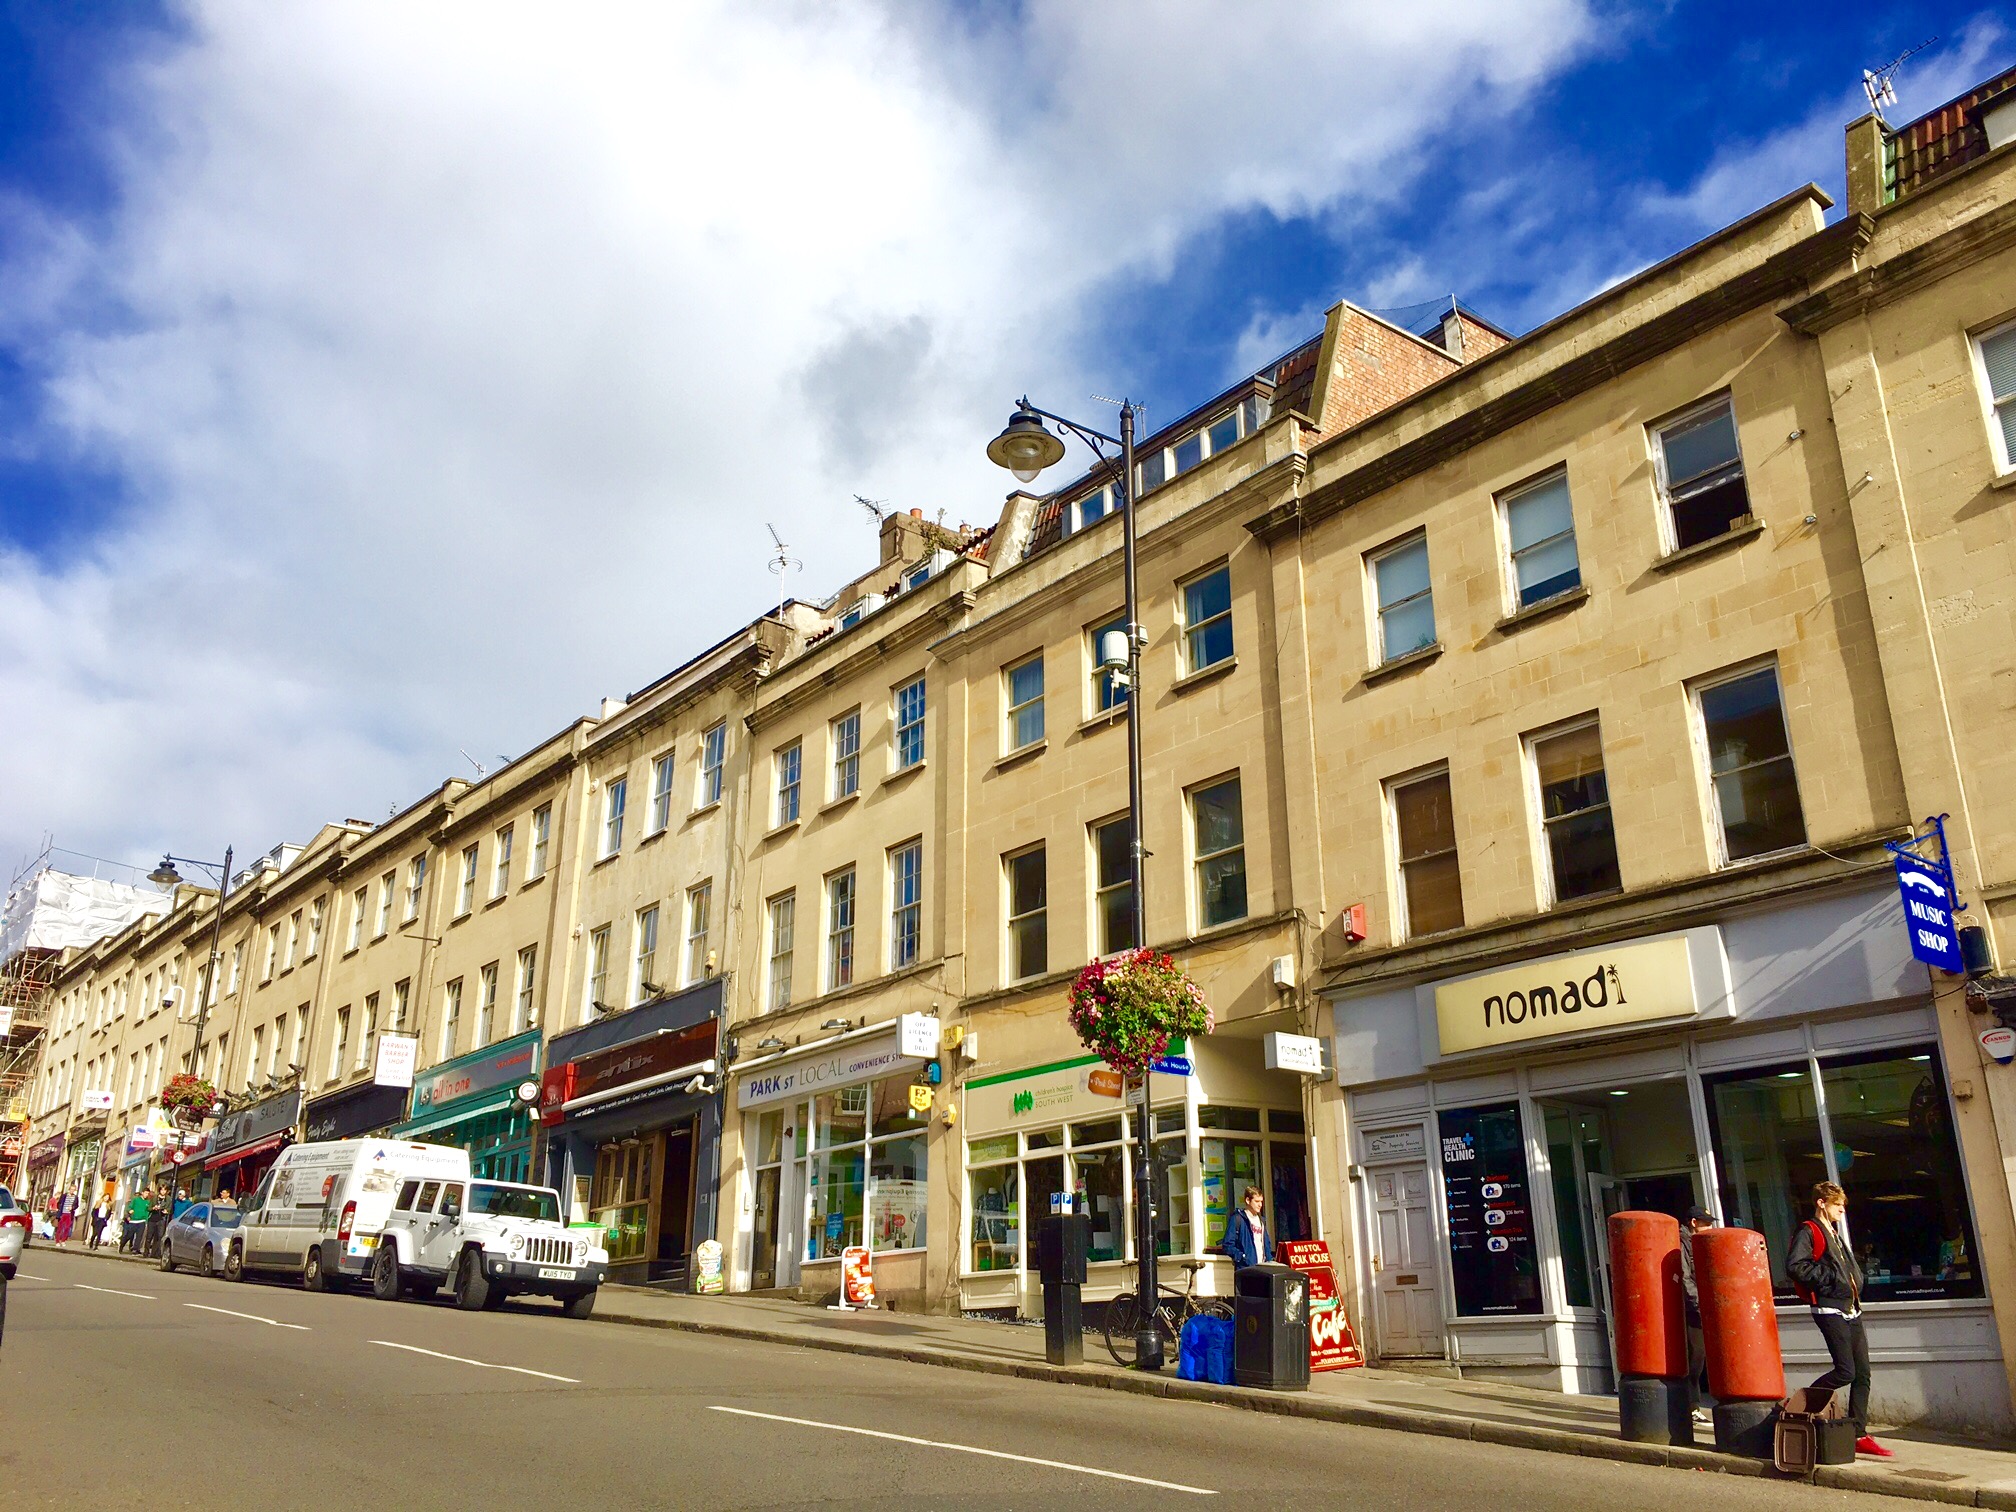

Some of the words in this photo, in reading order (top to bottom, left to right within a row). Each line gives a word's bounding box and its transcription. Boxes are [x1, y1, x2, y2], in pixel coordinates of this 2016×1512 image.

[1909, 899, 1948, 927] MUSIC
[1917, 928, 1949, 953] SHOP
[1483, 964, 1608, 1028] nomad
[1281, 1045, 1307, 1057] nomad
[1170, 1062, 1190, 1071] House
[750, 1075, 782, 1098] PARK
[784, 1075, 795, 1090] ST
[800, 1058, 845, 1086] LOCAL
[848, 1054, 891, 1073] CONVENIENCE
[433, 1079, 443, 1100] all
[445, 1080, 453, 1095] in
[455, 1077, 471, 1093] one
[520, 1084, 535, 1095] G
[1056, 1084, 1074, 1093] hospice
[1034, 1098, 1056, 1109] SOUTH
[1057, 1095, 1074, 1104] WEST
[1442, 1136, 1462, 1145] TRAVEL
[1443, 1143, 1466, 1152] HEALTH
[390, 1152, 420, 1161] Catering
[421, 1155, 459, 1164] Equipment
[1444, 1149, 1475, 1162] CLINIC
[1064, 1194, 1070, 1204] P
[1293, 1244, 1322, 1253] BRISTOL
[1290, 1255, 1308, 1265] FOLK
[1309, 1253, 1330, 1263] HOUSE
[1311, 1306, 1347, 1347] Café
